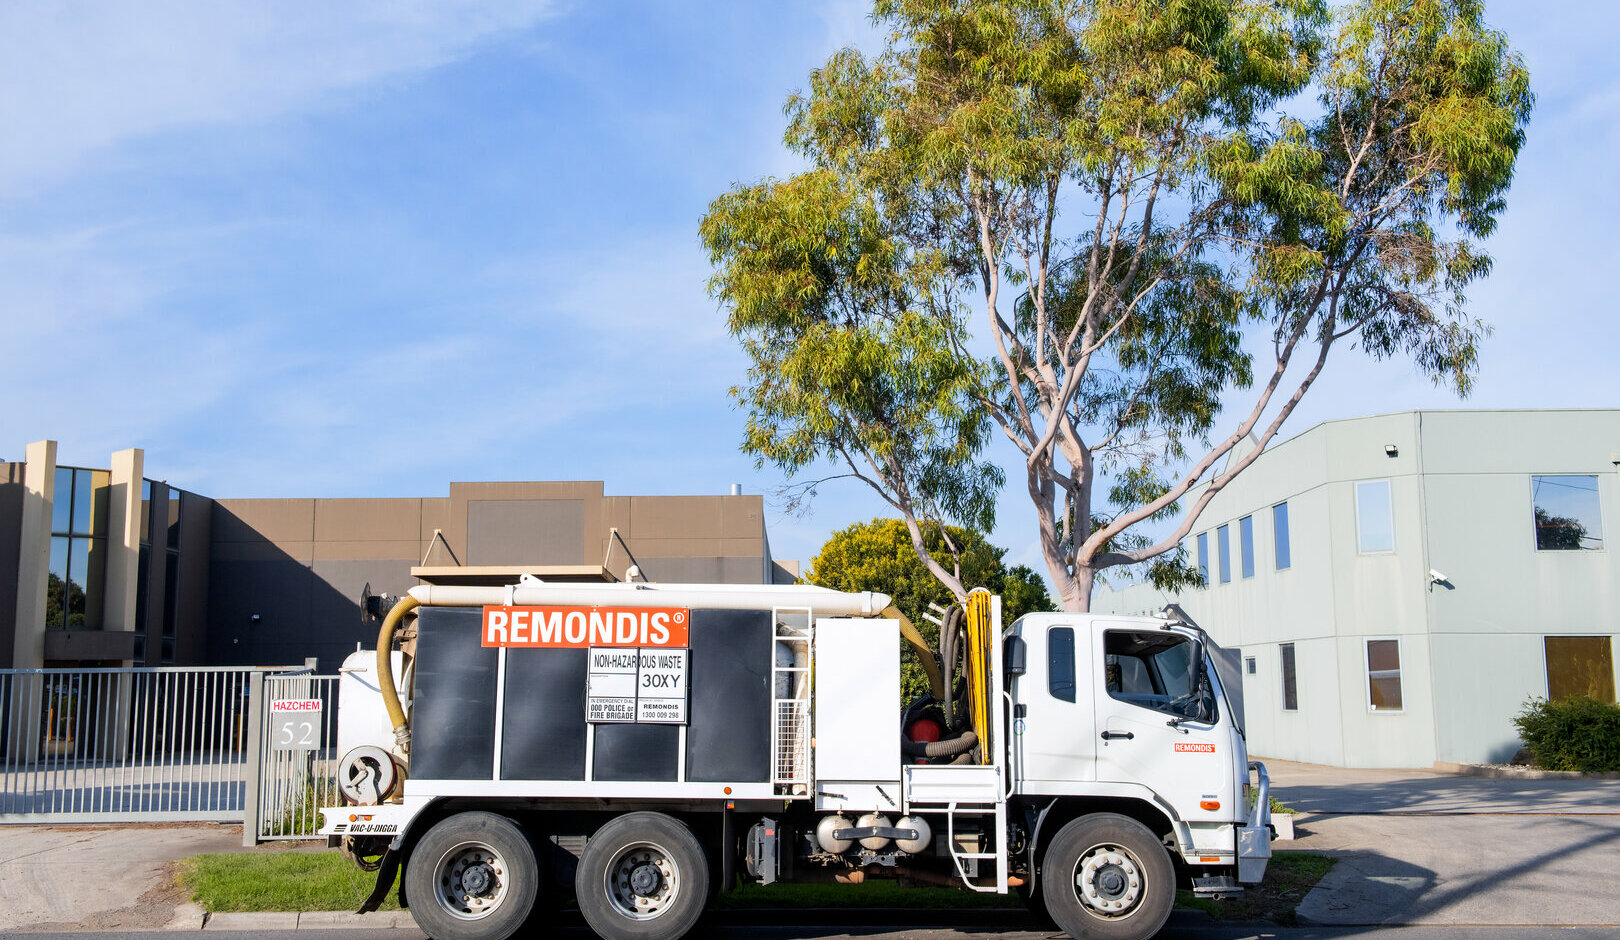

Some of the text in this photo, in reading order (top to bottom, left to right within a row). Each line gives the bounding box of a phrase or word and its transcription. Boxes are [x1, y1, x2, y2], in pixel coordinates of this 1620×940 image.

[658, 655, 682, 669] WASTE
[273, 701, 320, 711] HAZCHEM
[603, 704, 626, 712] POLICE
[590, 711, 634, 720] FIRE BRIGADE
[642, 711, 656, 719] 1300
[280, 721, 313, 745] 52
[350, 824, 398, 833] VAC-U-DIGGA
